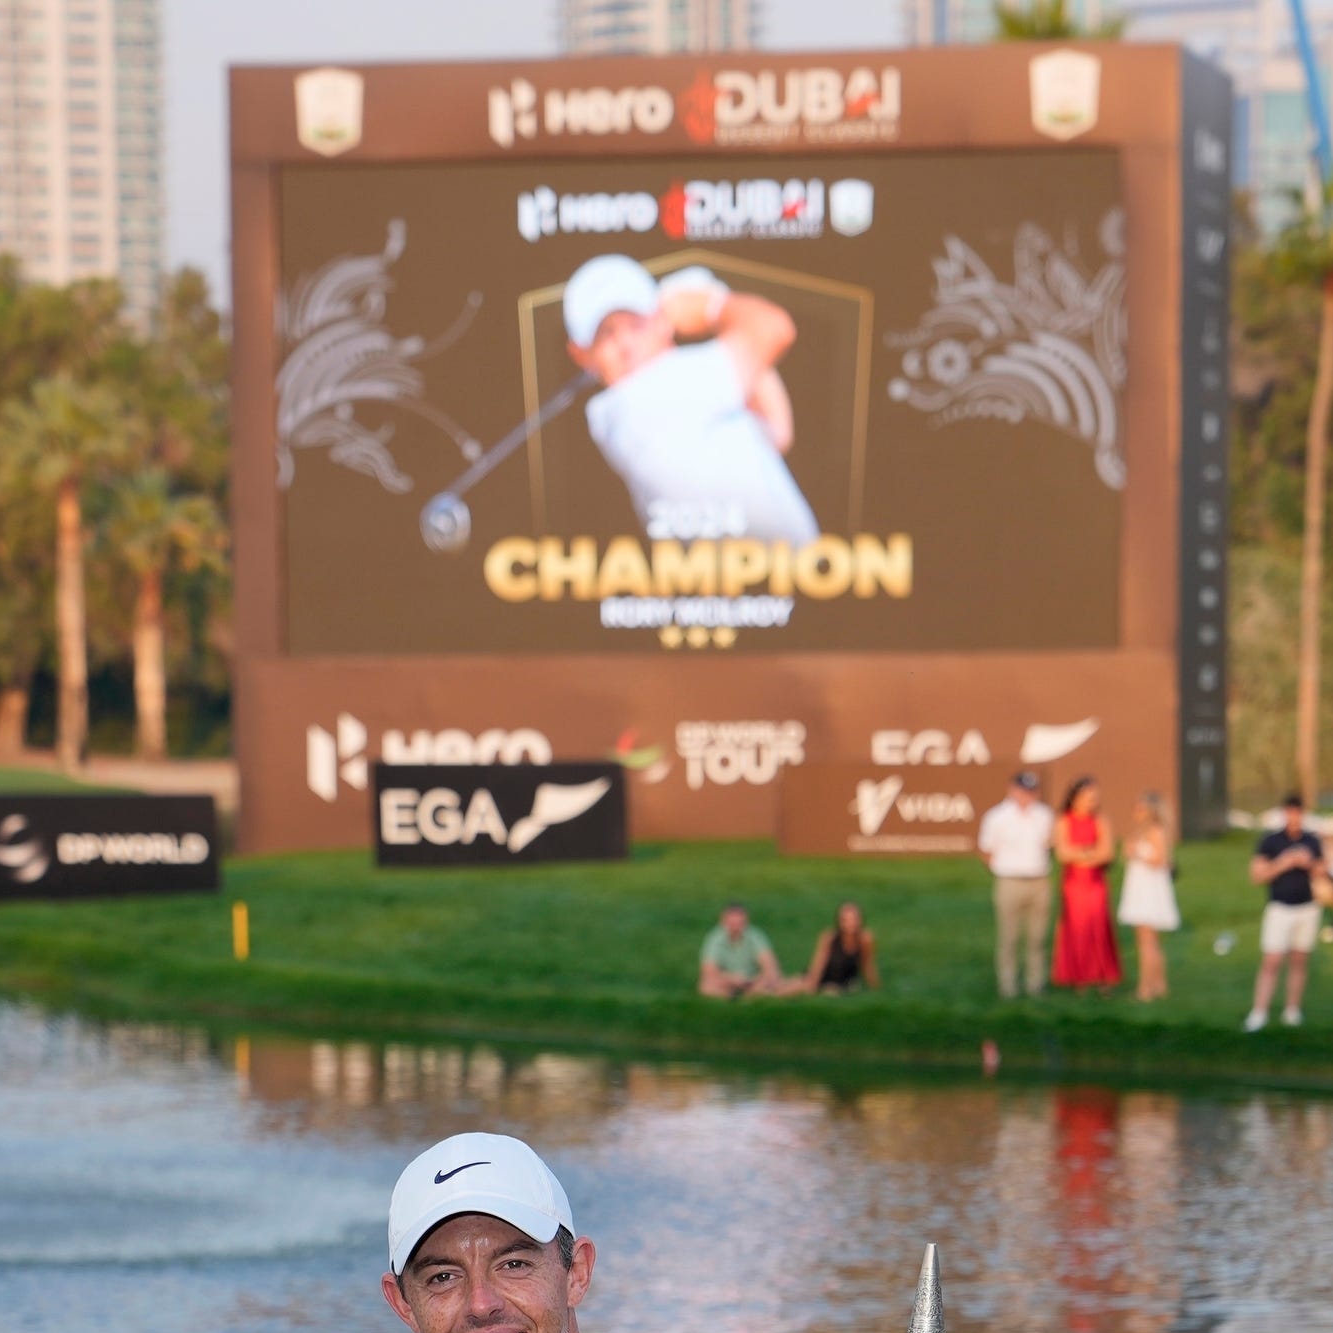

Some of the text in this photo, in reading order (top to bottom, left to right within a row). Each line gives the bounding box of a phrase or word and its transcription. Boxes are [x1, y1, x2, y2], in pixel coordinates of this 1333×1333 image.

[546, 68, 901, 134] Hero DUBAI
[560, 180, 823, 232] Hero DUBAI
[485, 533, 912, 600] CHAMPION
[602, 597, 671, 626] RORY
[380, 788, 508, 845] EGA
[58, 835, 208, 863] DP WORLD
